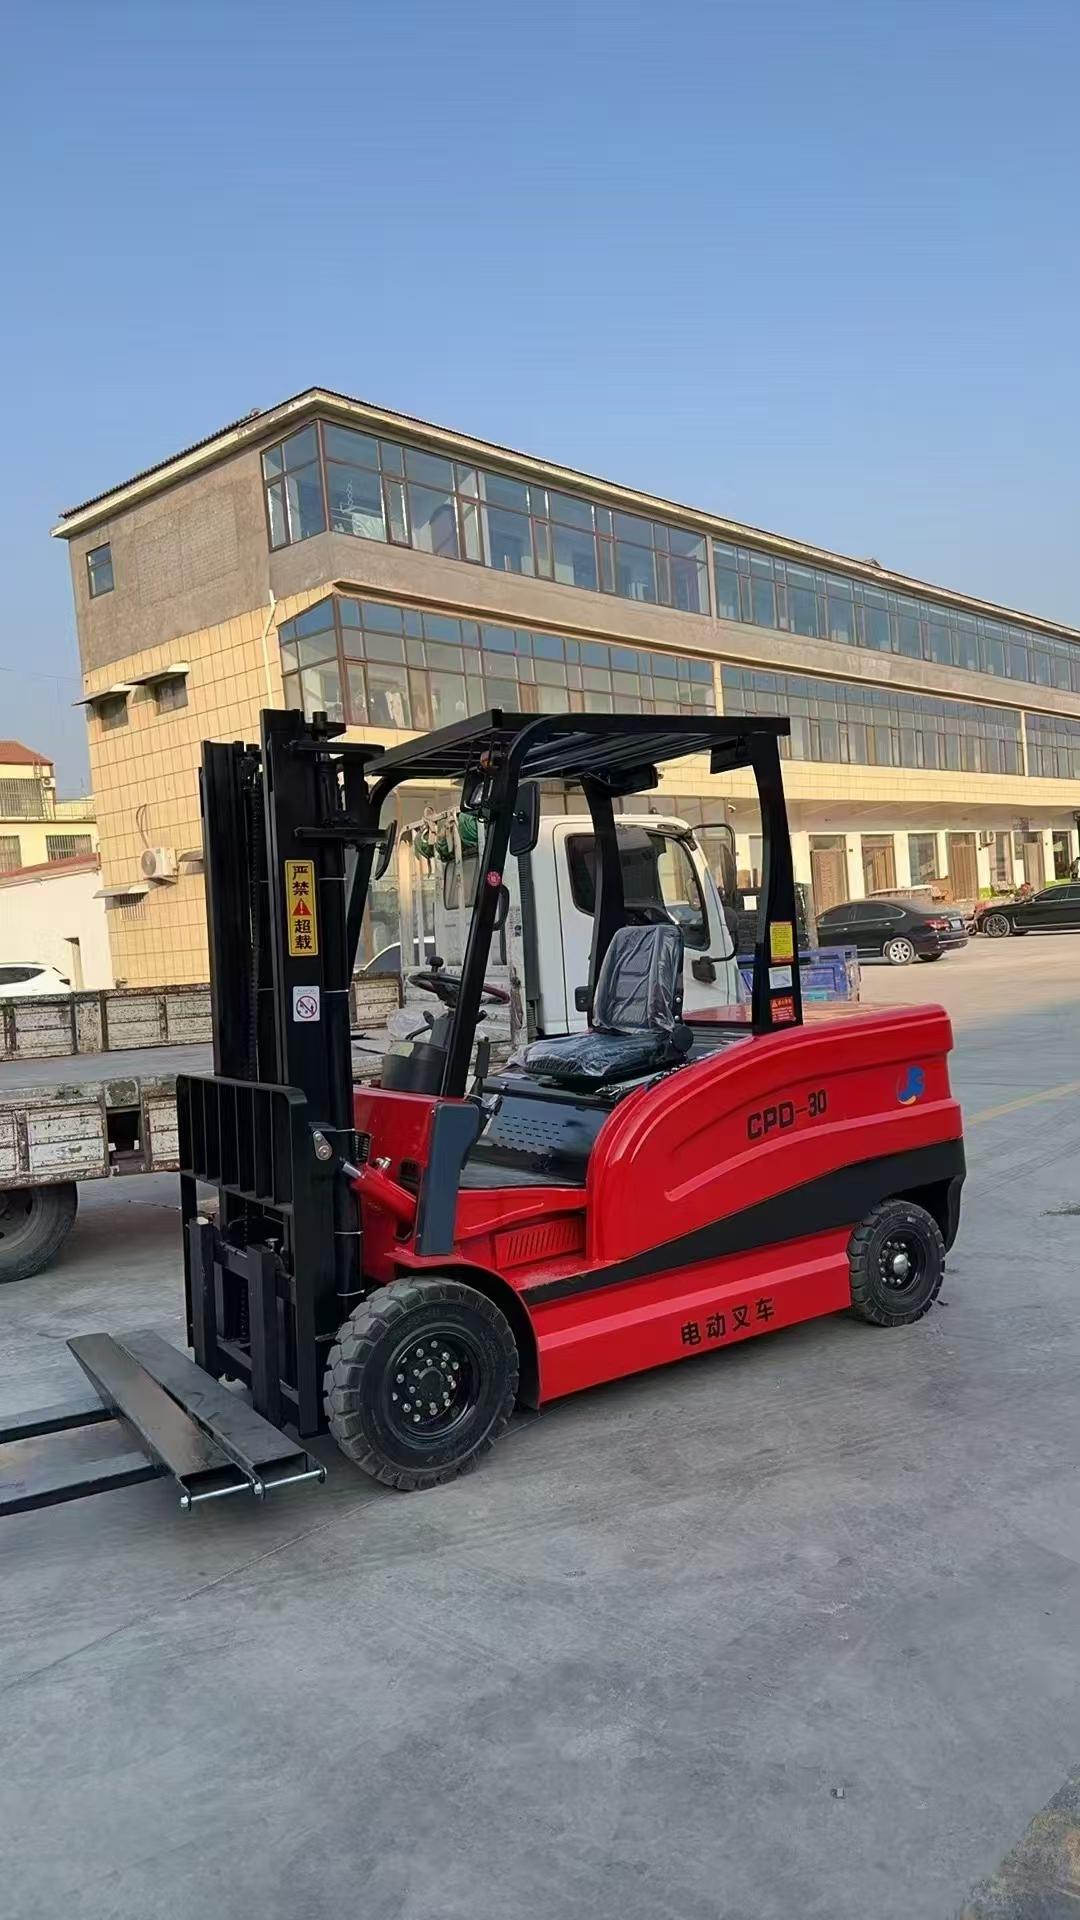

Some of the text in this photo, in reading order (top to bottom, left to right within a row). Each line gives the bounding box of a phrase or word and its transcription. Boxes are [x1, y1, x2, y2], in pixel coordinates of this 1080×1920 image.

[746, 1089, 828, 1140] CPD-30
[681, 1297, 775, 1345] 电动叉车
